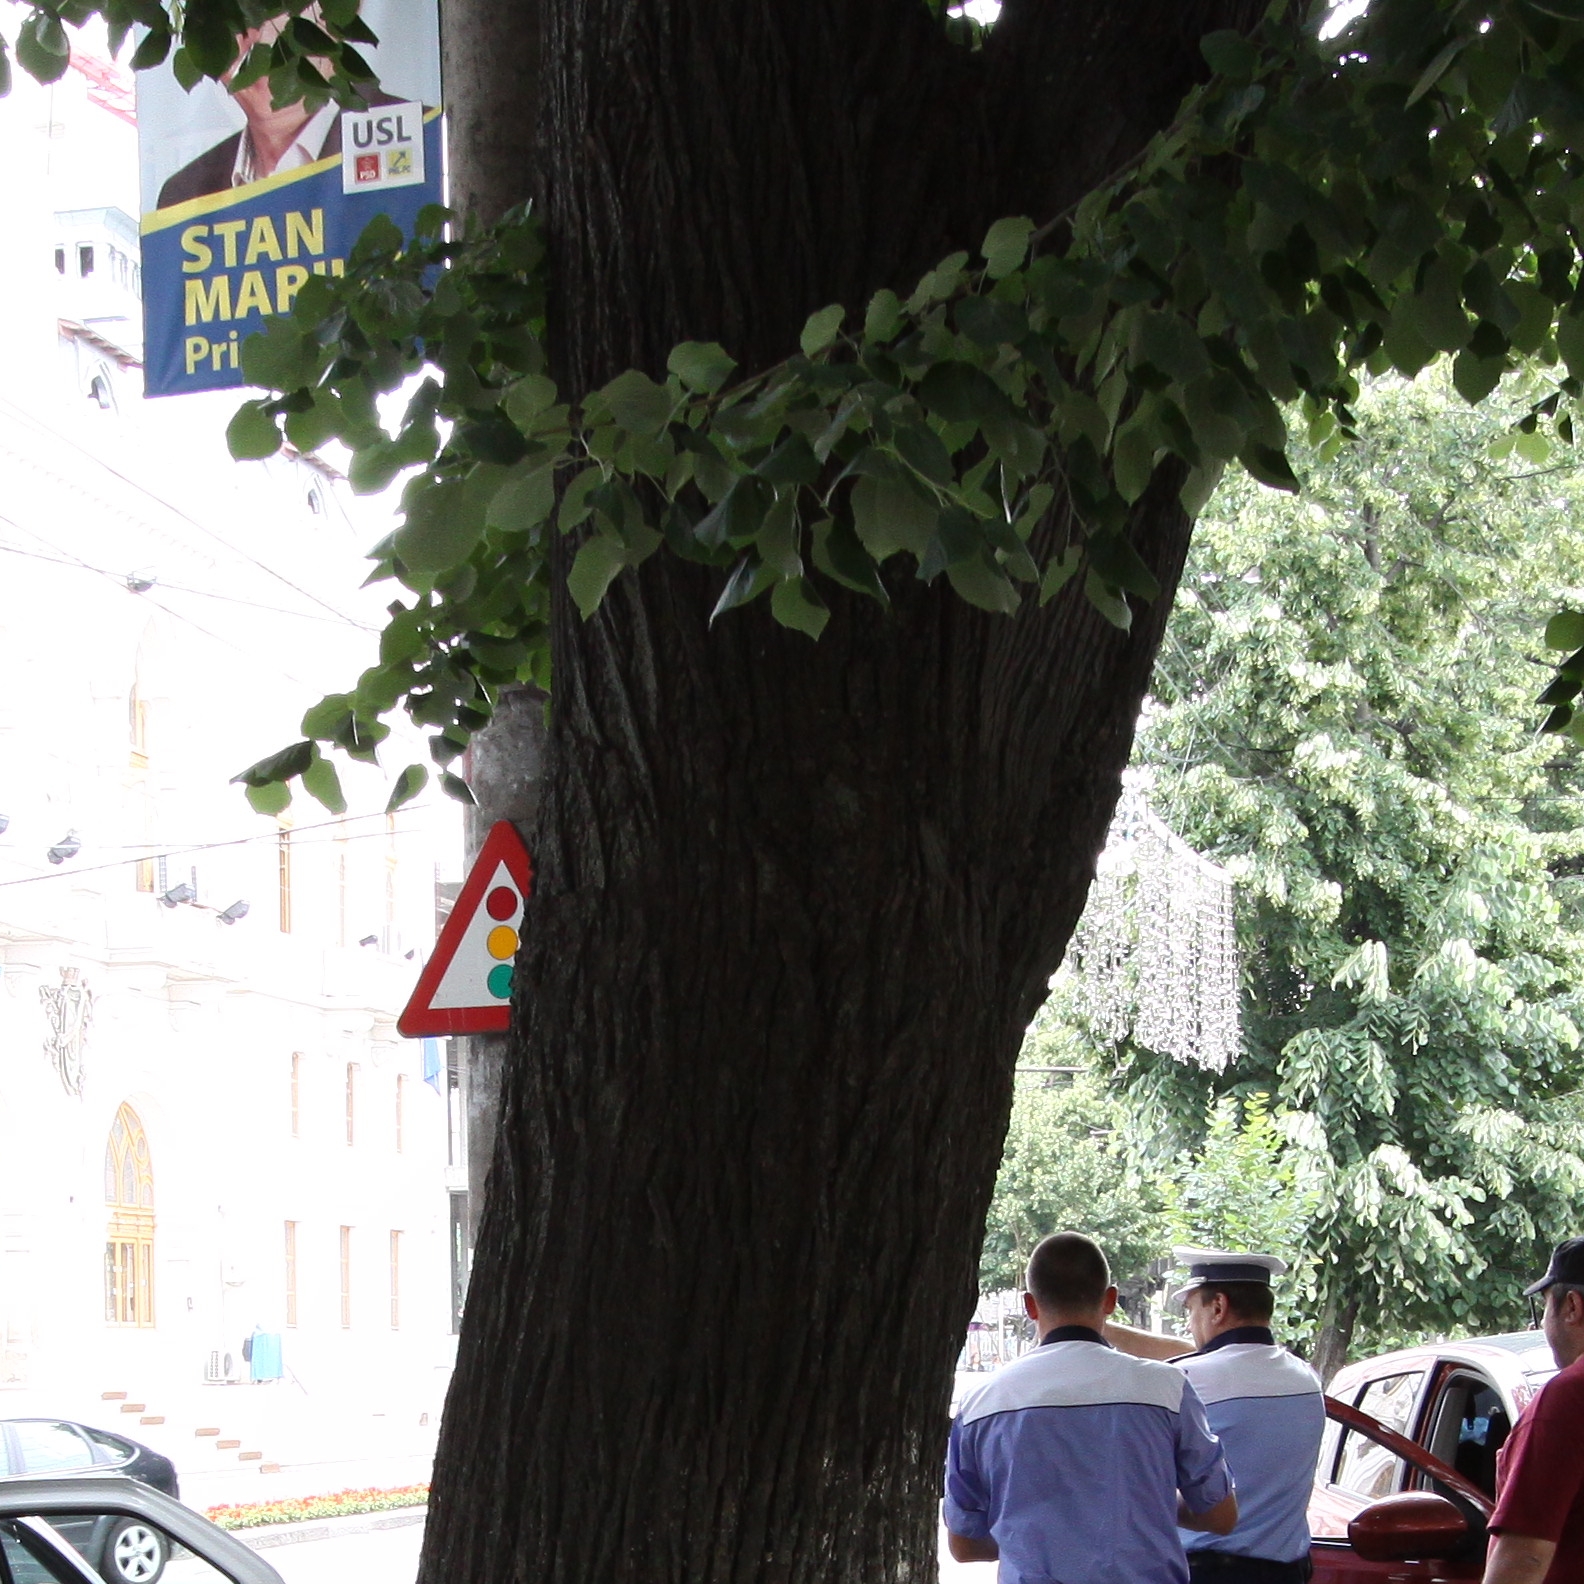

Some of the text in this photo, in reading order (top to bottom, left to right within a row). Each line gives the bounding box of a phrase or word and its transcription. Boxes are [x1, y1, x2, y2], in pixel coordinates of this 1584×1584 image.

[353, 115, 412, 148] USL
[181, 208, 325, 273] STAN
[185, 258, 345, 326] MAR
